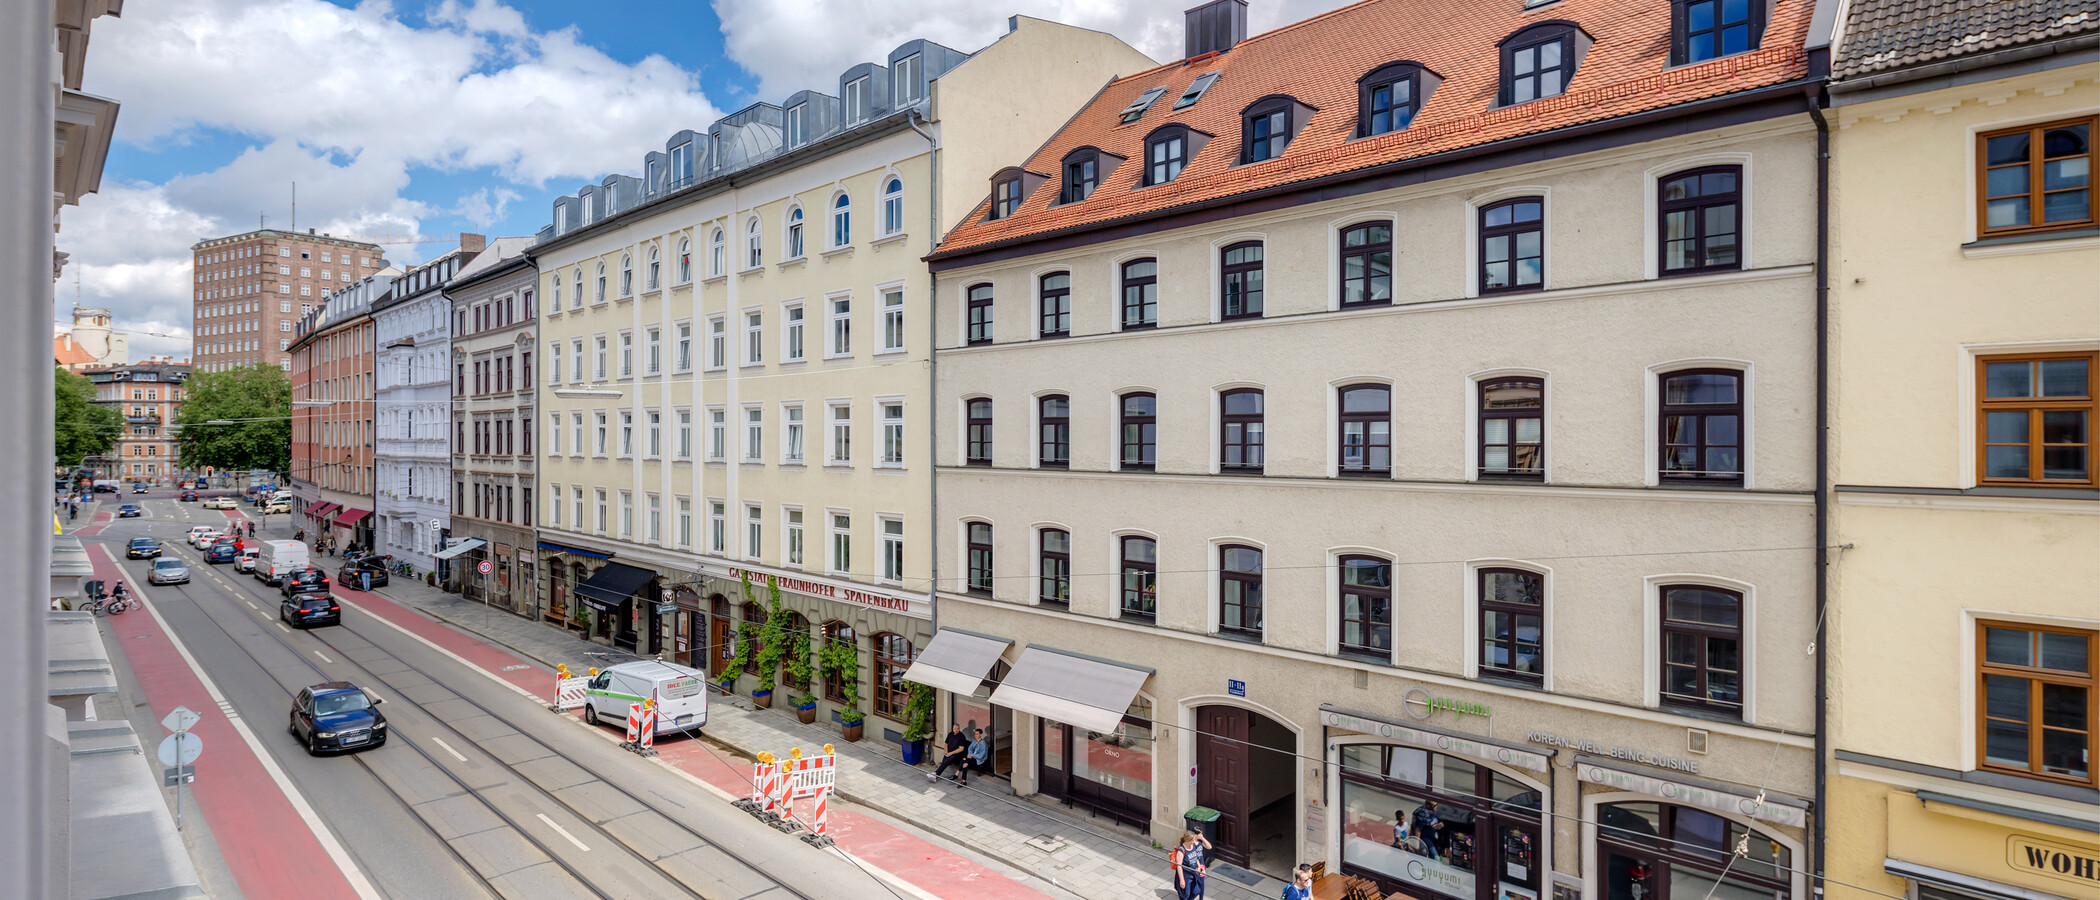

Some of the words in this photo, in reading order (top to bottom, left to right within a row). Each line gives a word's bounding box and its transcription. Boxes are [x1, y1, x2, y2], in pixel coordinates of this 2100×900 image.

[778, 577, 835, 597] FRAUNHOFER
[1527, 731, 1569, 748] KOREAN
[1576, 740, 1605, 755] WELL
[1610, 746, 1645, 763] BEING
[1650, 754, 1698, 773] CUISINE
[2024, 845, 2100, 881] WOH
